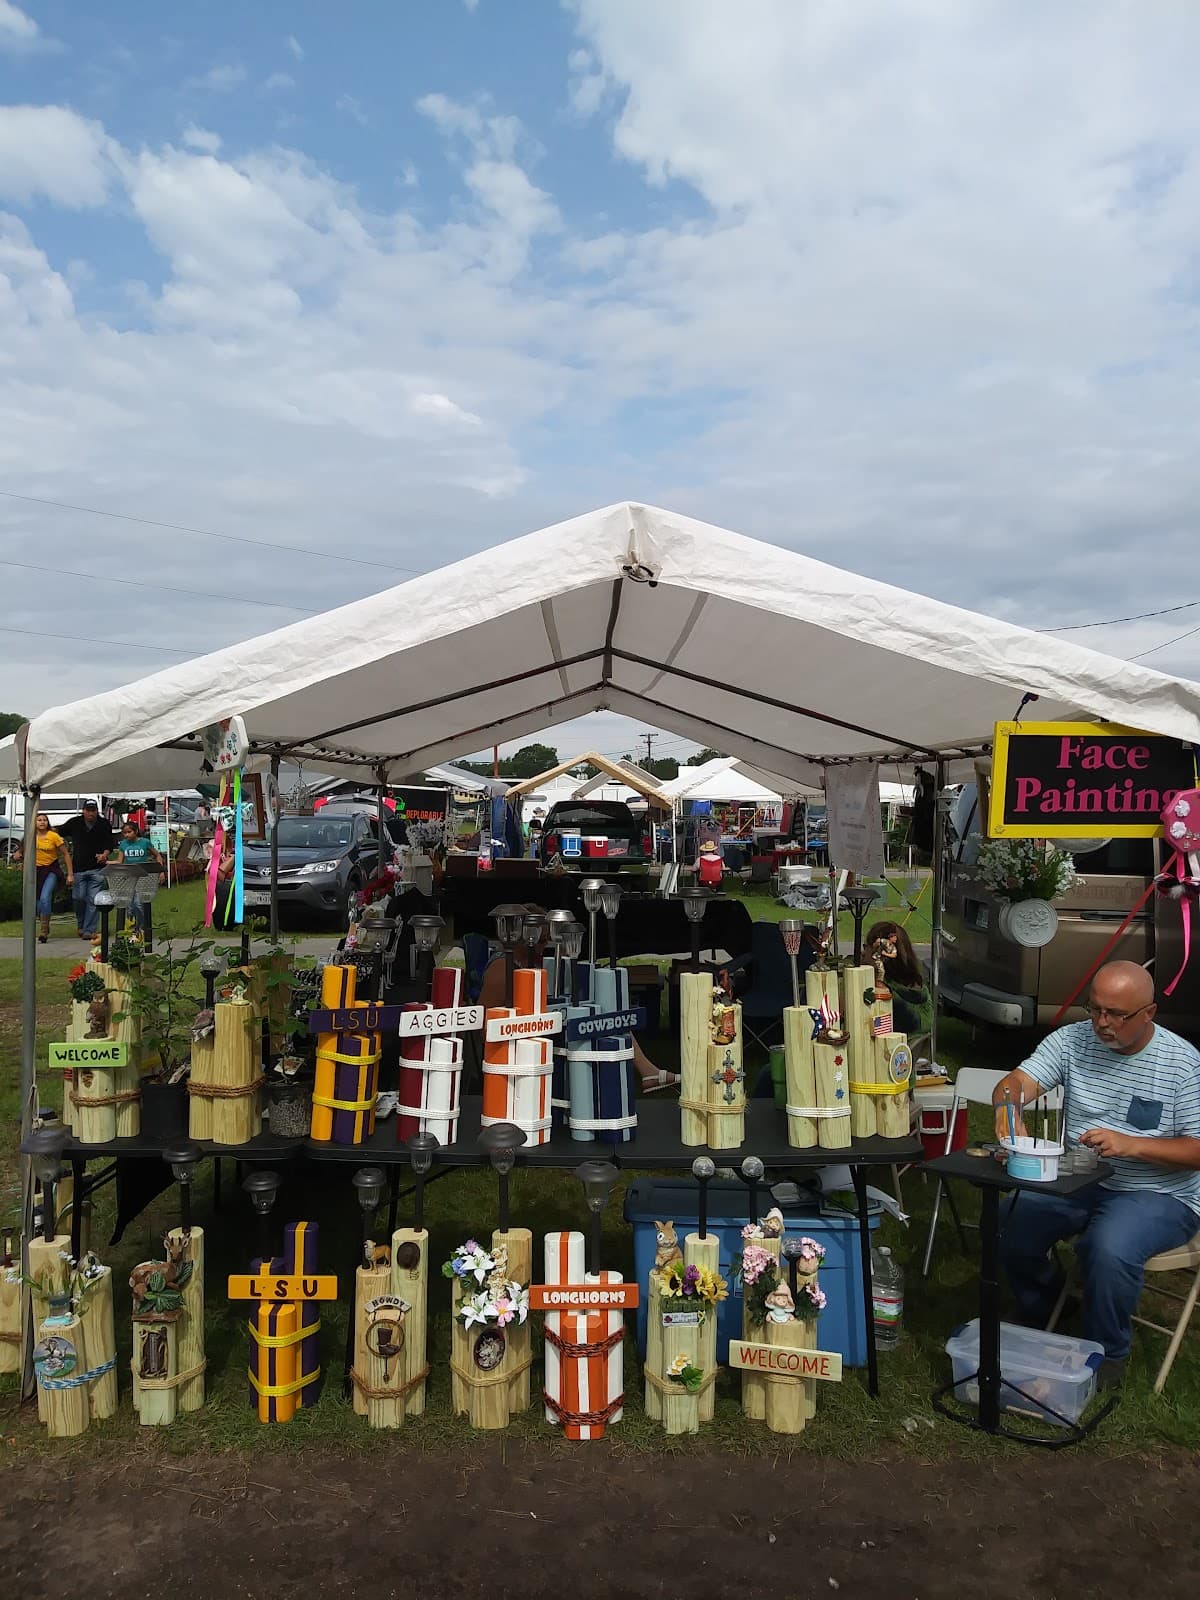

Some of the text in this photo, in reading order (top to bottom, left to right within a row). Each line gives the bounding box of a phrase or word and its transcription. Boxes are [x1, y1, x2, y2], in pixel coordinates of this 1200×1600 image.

[1056, 735, 1150, 769] Face
[406, 809, 444, 820] DEPLORABLE
[332, 1010, 379, 1030] LSU
[409, 1009, 477, 1030] AGGIES
[500, 1019, 554, 1036] LONGHORNS
[578, 1013, 638, 1034] COWBOYS
[55, 1047, 120, 1061] WELCOME
[371, 1297, 406, 1308] HOWDY
[542, 1291, 626, 1304] LONGHORNS
[739, 1346, 831, 1376] WELCOME
